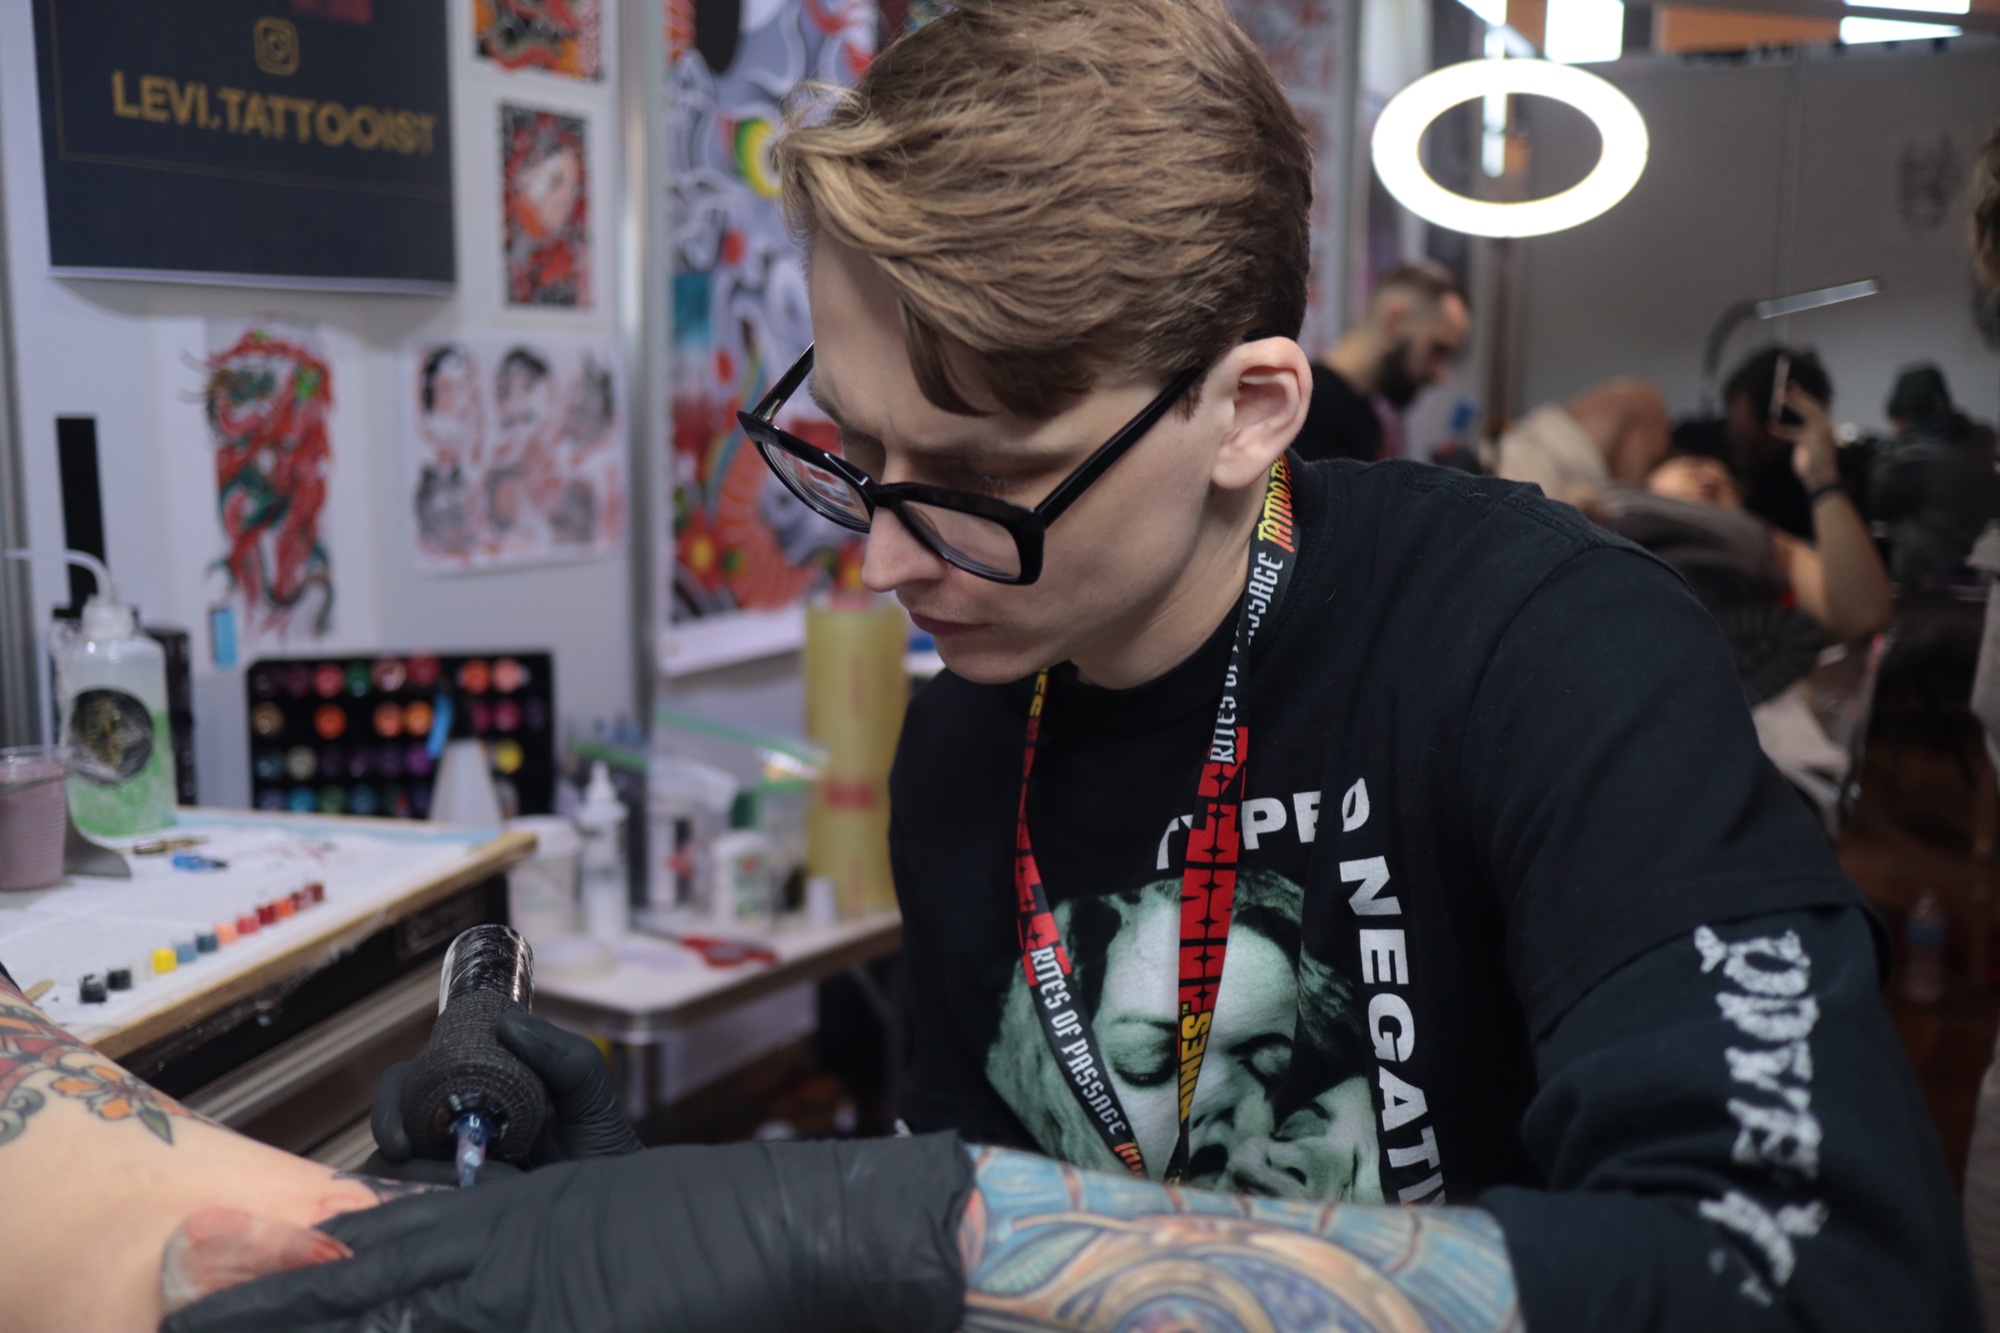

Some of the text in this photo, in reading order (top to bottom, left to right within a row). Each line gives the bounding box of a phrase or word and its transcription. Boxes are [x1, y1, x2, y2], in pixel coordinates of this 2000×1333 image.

[111, 69, 437, 155] LEVI.TATTOOIST
[1030, 945, 1127, 1135] RITES OF PASSAGE
